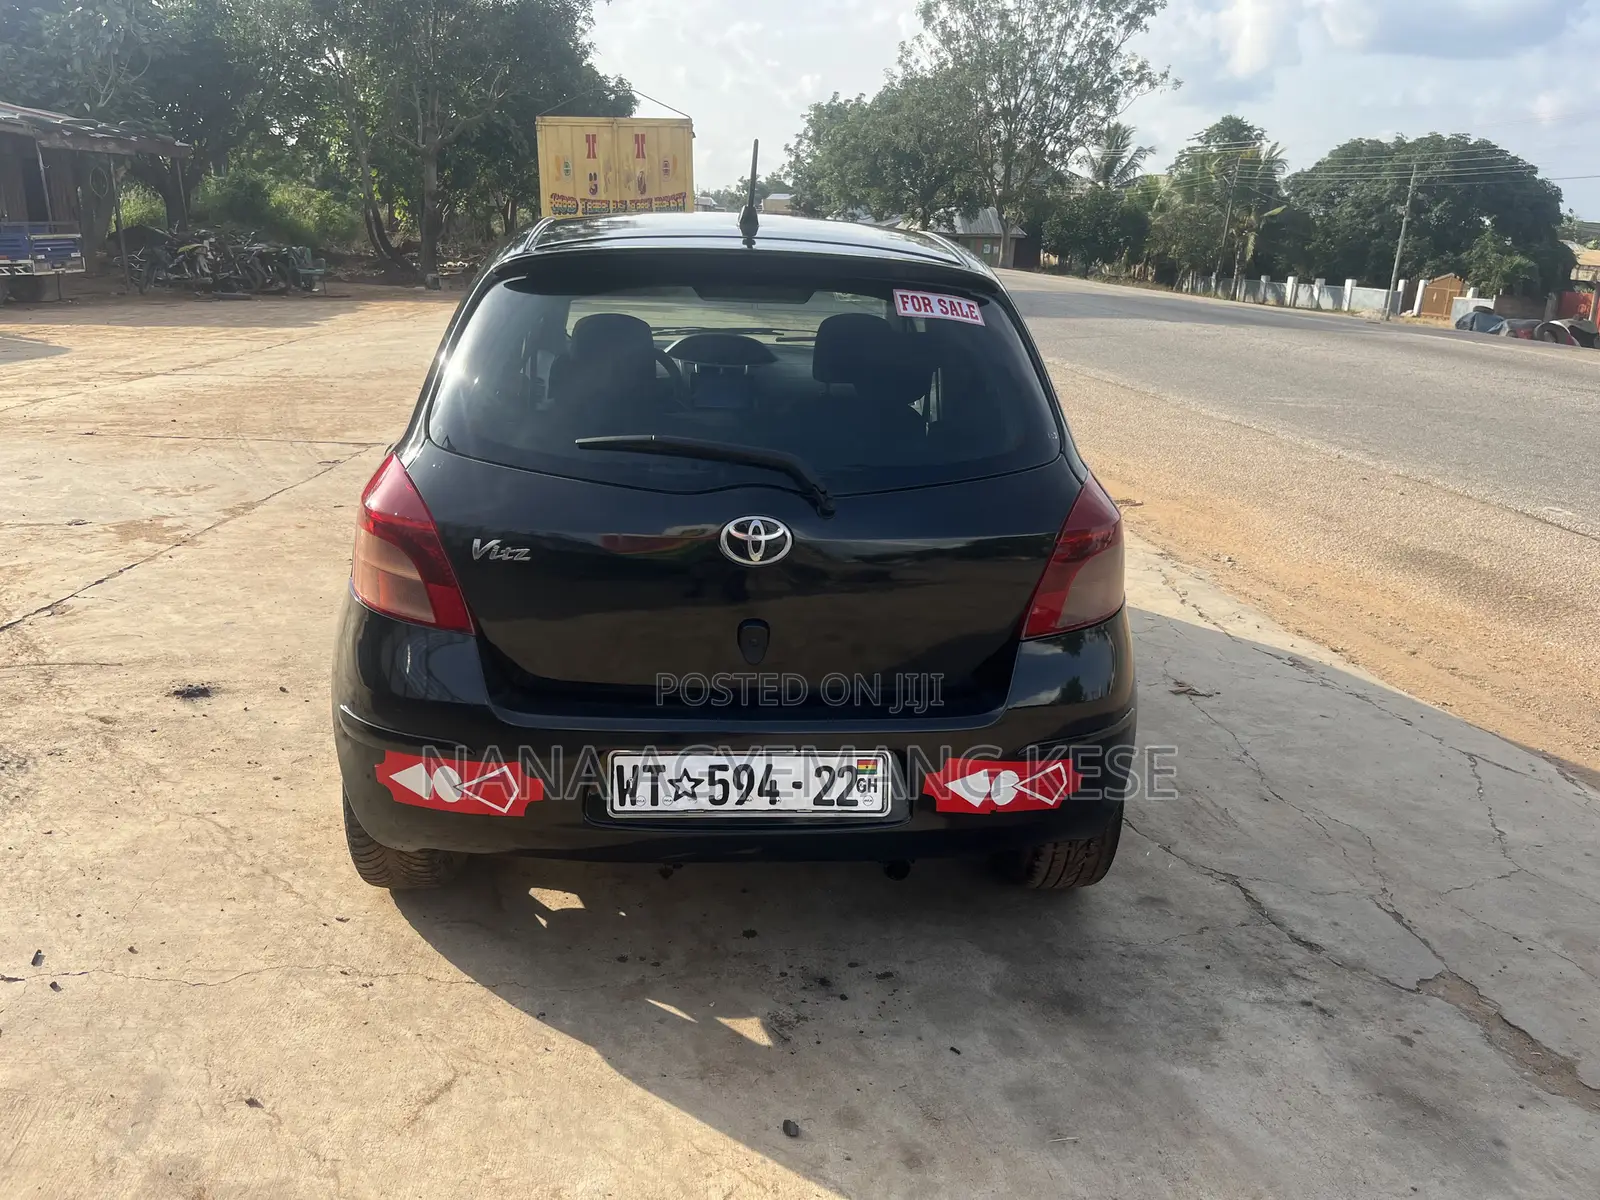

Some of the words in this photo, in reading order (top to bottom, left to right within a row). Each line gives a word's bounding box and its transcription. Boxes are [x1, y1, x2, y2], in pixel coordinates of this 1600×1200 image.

[899, 294, 935, 313] FOR
[937, 298, 979, 321] SALE
[472, 538, 532, 561] Vitz
[616, 764, 666, 807] WT
[856, 777, 878, 794] GH
